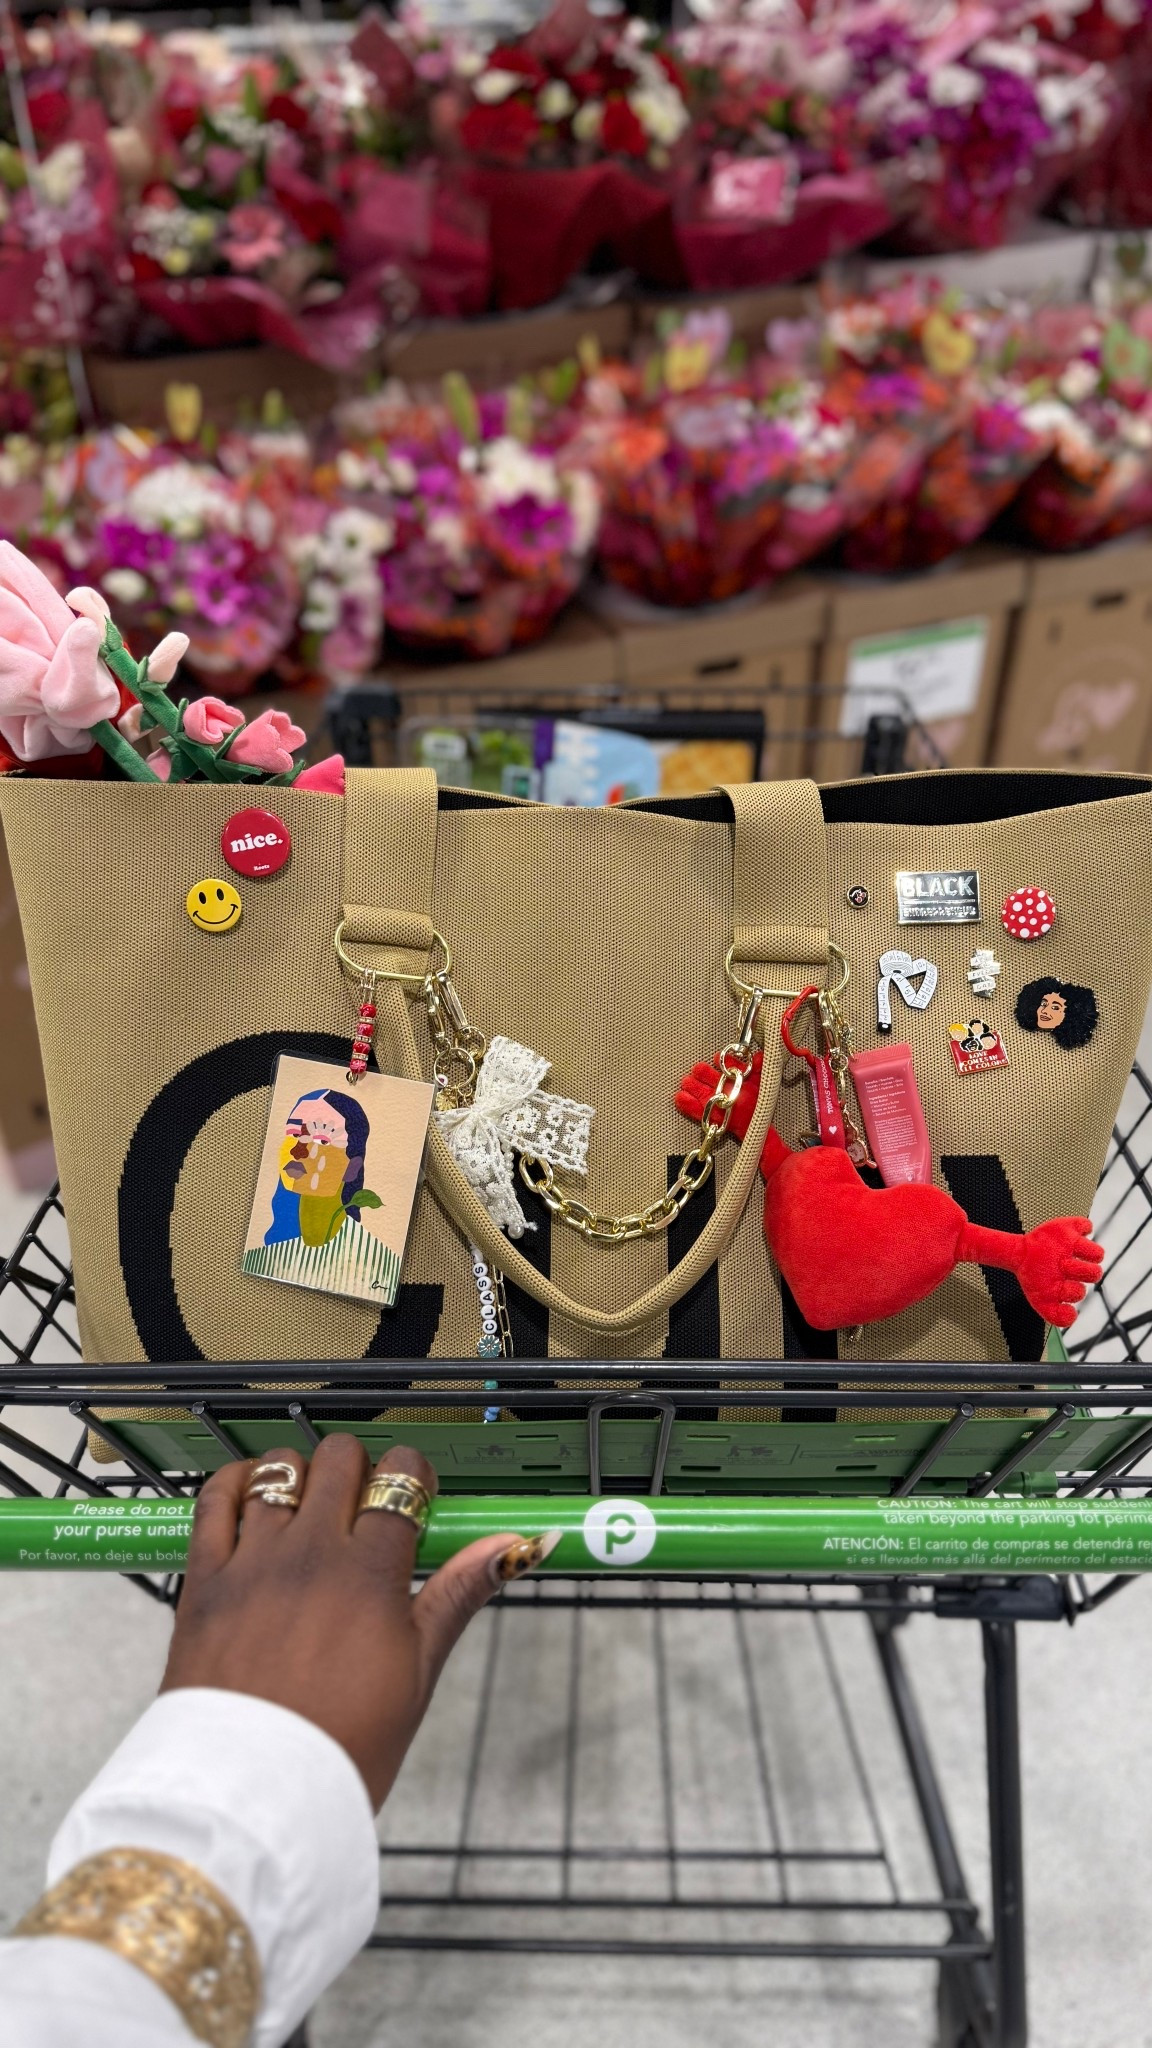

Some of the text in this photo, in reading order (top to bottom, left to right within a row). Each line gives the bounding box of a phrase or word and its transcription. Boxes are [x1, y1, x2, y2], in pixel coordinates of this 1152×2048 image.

[230, 833, 283, 853] nice.
[900, 876, 975, 897] BLACK
[474, 1264, 496, 1332] CLASS
[73, 1503, 125, 1515] Please
[130, 1503, 151, 1515] do
[156, 1505, 185, 1515] not
[877, 1500, 957, 1509] CAUTION:
[962, 1500, 989, 1509] The
[994, 1500, 1023, 1509] cart
[1026, 1500, 1050, 1509] will
[1055, 1500, 1088, 1510] stop
[883, 1511, 925, 1524] taken
[929, 1511, 987, 1528] beyond
[990, 1511, 1015, 1524] the
[1019, 1511, 1076, 1528] parking
[1080, 1510, 1101, 1524] lot
[53, 1523, 193, 1541] your purse unatt
[823, 1534, 904, 1550] ATENCIÓN:
[909, 1537, 921, 1550] El
[925, 1537, 968, 1550] carrito
[972, 1536, 989, 1550] de
[993, 1539, 1051, 1553] compras
[1054, 1539, 1069, 1550] se
[1072, 1536, 1133, 1550] detendrá
[20, 1549, 41, 1561] Por
[45, 1548, 80, 1562] favor,
[84, 1551, 101, 1561] no
[105, 1549, 134, 1564] deje
[138, 1551, 152, 1561] su
[846, 1554, 857, 1565] si
[861, 1556, 876, 1565] es
[880, 1553, 928, 1565] llevado
[932, 1554, 958, 1565] más
[963, 1553, 986, 1565] allá
[990, 1553, 1011, 1565] del
[1015, 1553, 1081, 1567] perímetro
[1084, 1553, 1105, 1565] del
